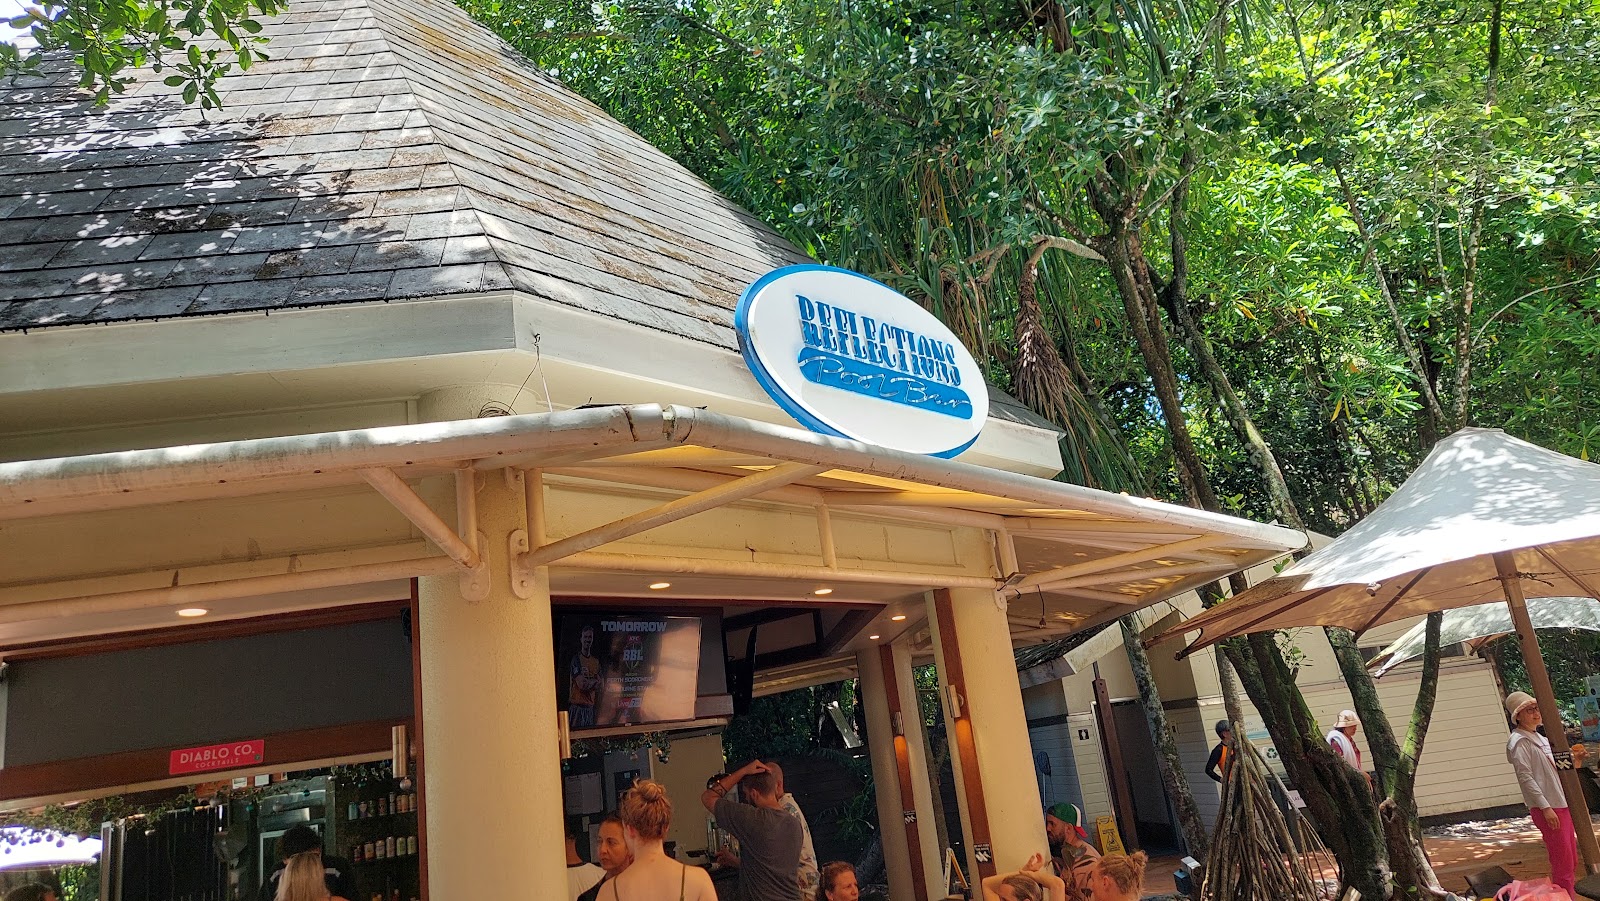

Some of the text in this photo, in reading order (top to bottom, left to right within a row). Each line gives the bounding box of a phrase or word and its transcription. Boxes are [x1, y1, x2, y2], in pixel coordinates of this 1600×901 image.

[799, 355, 970, 408] Pool Bar
[600, 620, 667, 632] TOMORROW
[623, 649, 644, 661] BBL
[180, 744, 255, 764] DIABLO CO.
[195, 757, 239, 769] COCKTAILS
